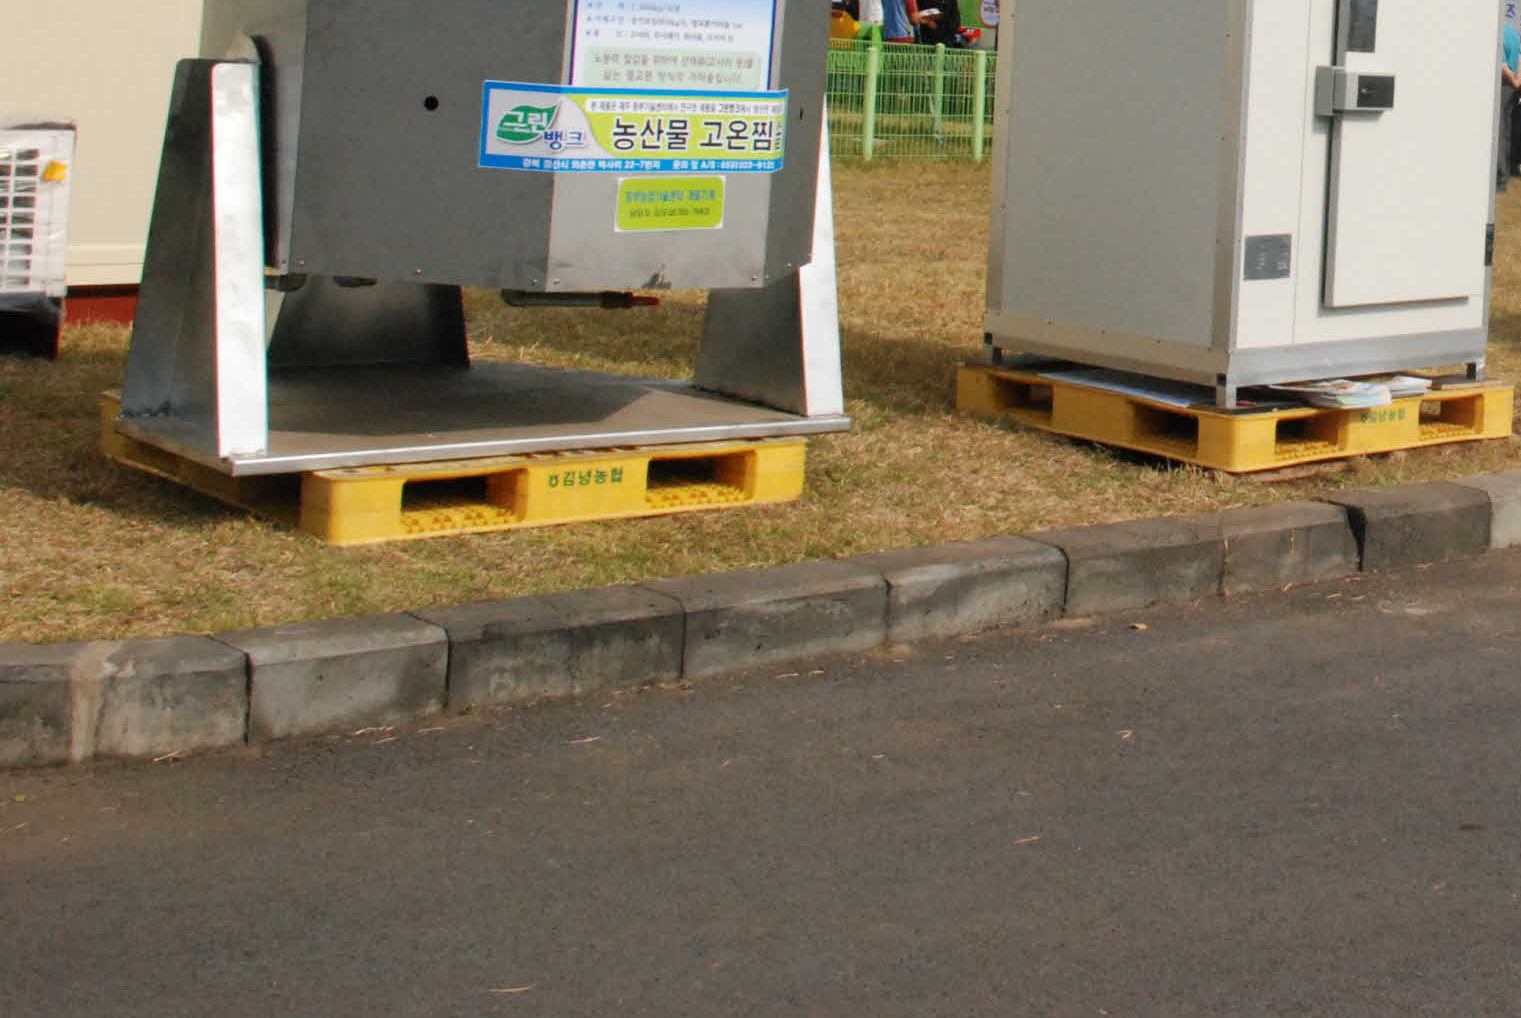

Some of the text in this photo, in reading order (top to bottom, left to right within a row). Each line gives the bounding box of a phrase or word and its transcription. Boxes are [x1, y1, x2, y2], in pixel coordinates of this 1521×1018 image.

[503, 111, 585, 151] 그린 뱅크
[611, 117, 689, 151] 농산물
